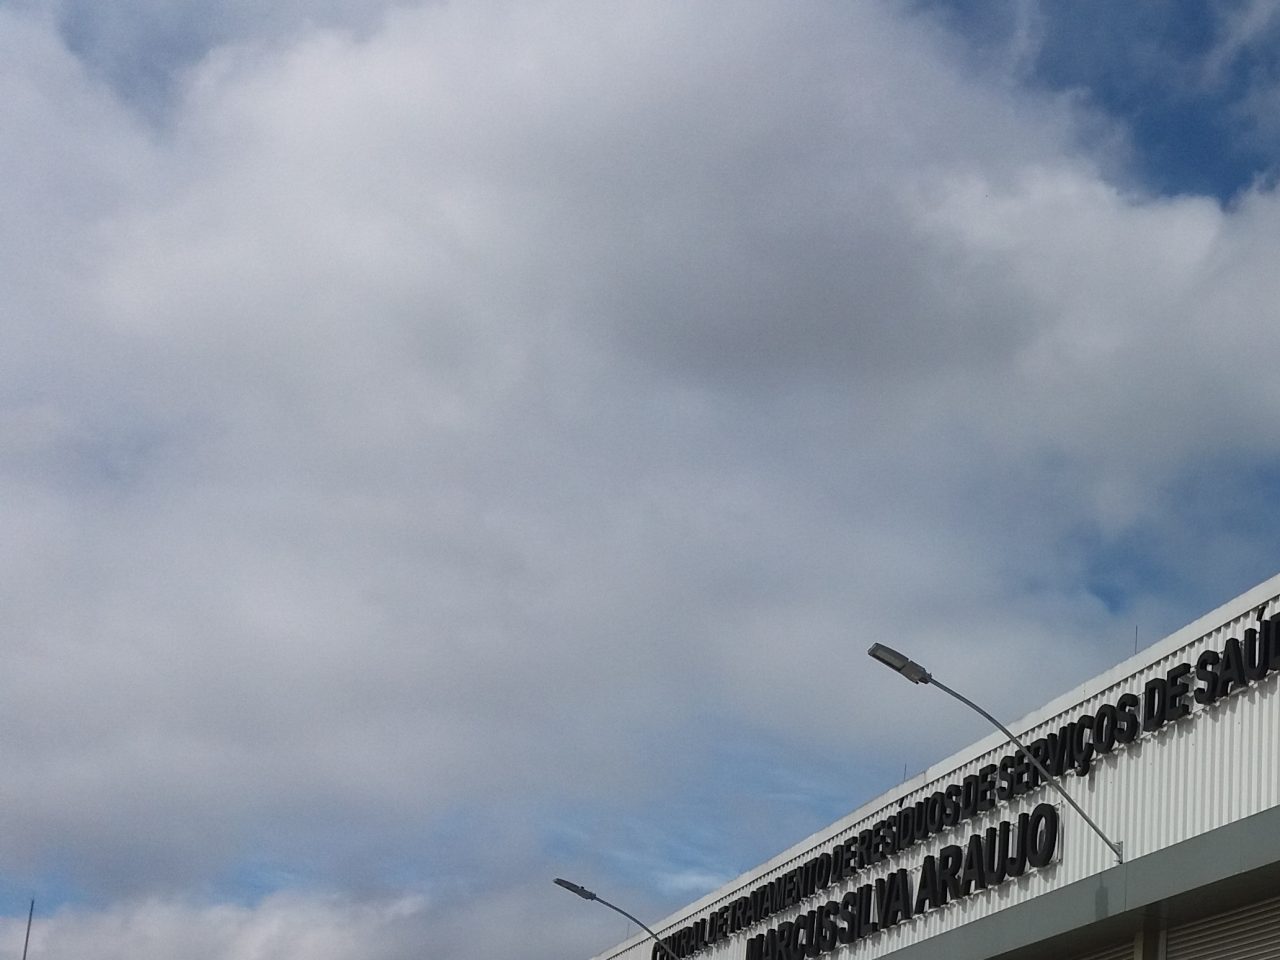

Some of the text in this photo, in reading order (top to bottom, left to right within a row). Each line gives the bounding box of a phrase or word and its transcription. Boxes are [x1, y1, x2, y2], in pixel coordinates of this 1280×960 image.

[707, 905, 730, 945] DE
[727, 853, 832, 935] TRATAMENTO
[831, 836, 858, 883] DE
[961, 763, 998, 820] DE
[998, 693, 1138, 801] SERVIÇOS
[1143, 662, 1192, 733] DE
[837, 868, 912, 944] SILVA
[914, 802, 1060, 914] ARAUJO
